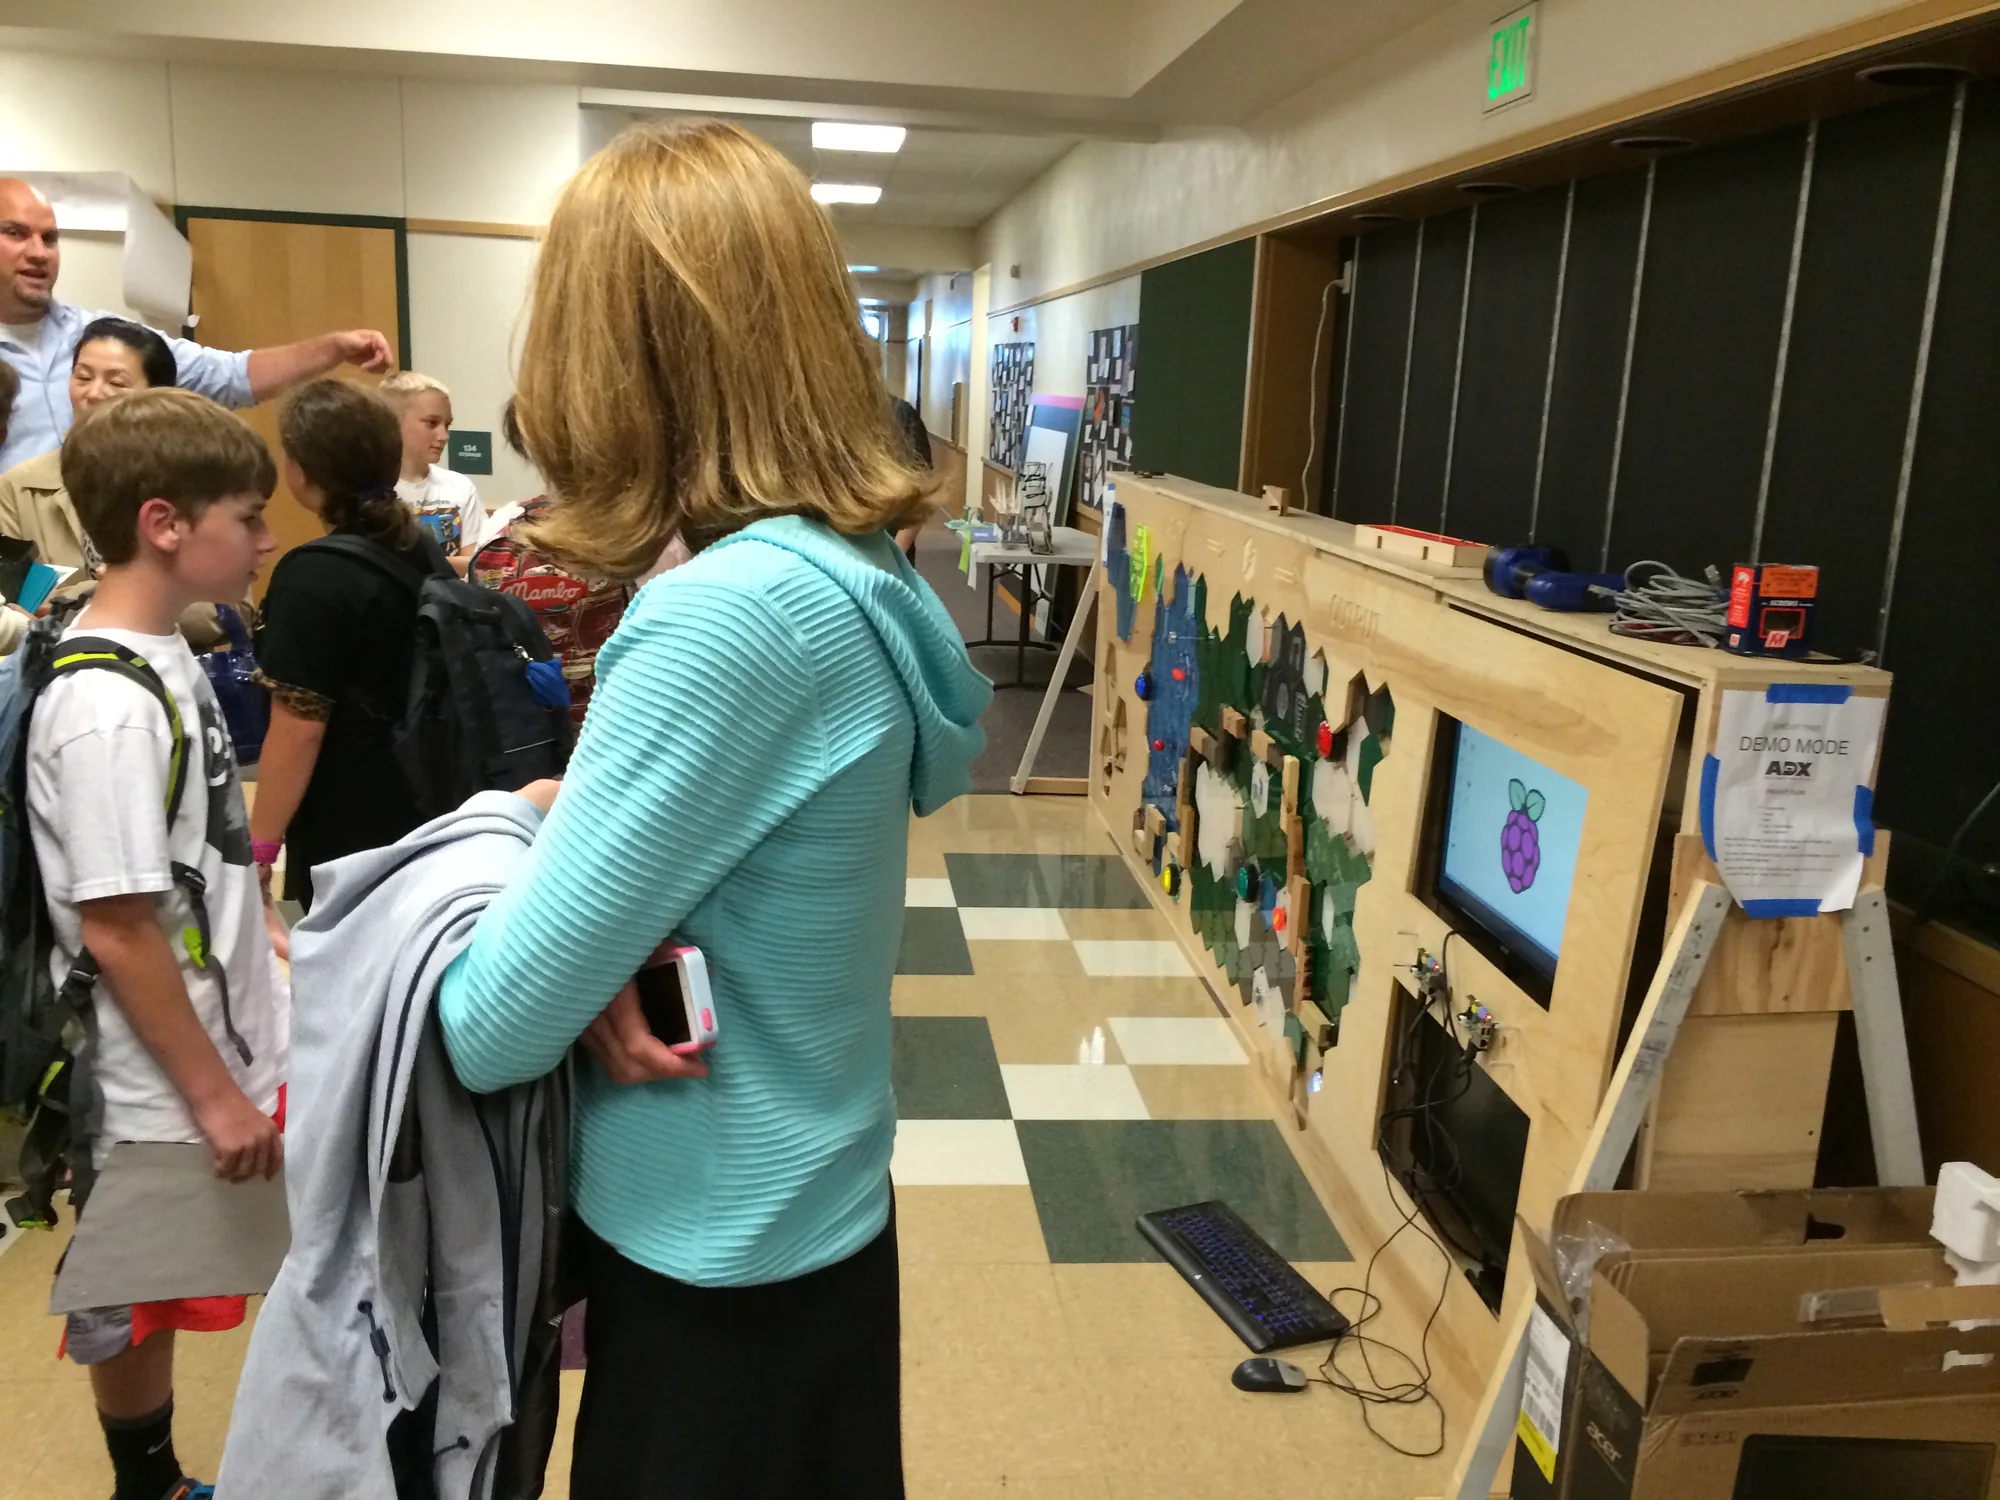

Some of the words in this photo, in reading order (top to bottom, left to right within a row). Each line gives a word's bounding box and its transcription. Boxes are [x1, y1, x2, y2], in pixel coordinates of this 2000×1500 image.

[1488, 16, 1530, 100] EXIT
[503, 580, 582, 601] Mambo
[1740, 736, 1791, 753] DEMO
[1796, 739, 1850, 756] MODE
[1586, 1420, 1622, 1462] acer
